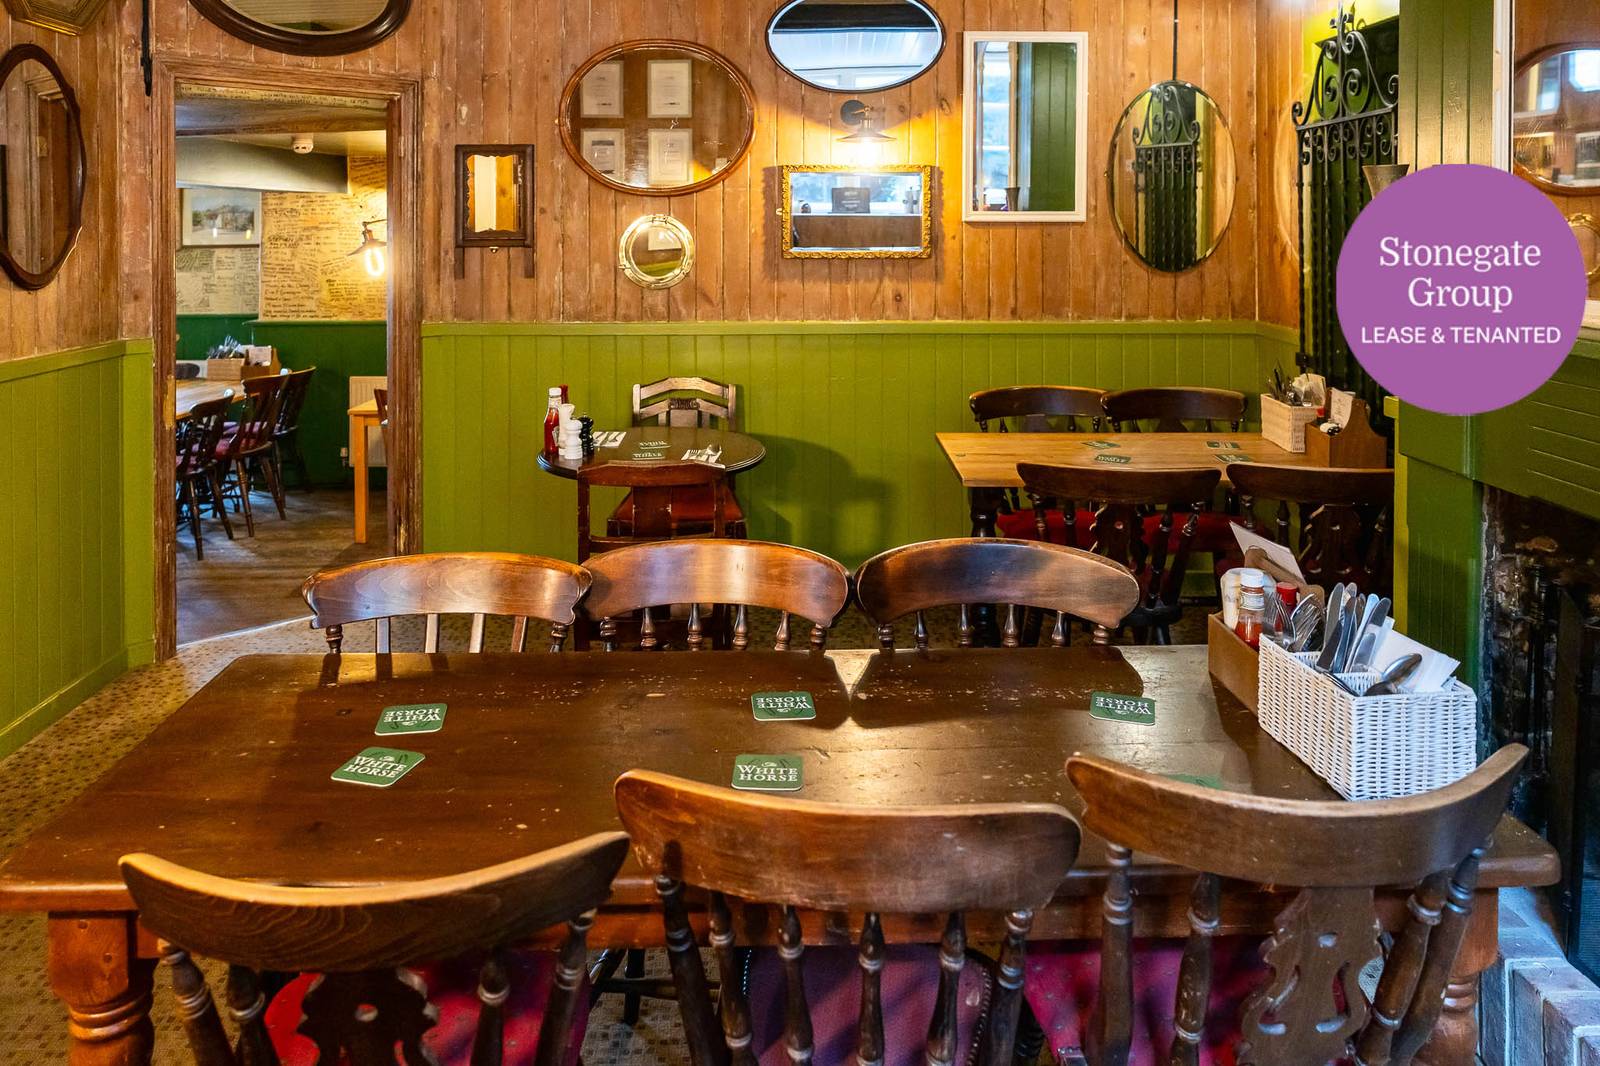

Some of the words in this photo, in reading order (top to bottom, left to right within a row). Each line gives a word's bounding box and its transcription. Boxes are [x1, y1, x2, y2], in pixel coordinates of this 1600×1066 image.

[1095, 696, 1149, 707] HORSE
[385, 708, 441, 717] HORSE
[1096, 701, 1152, 715] WHITE
[384, 713, 442, 723] WHITE
[354, 756, 407, 771] WHITE
[343, 764, 400, 778] HORSE
[736, 764, 798, 775] WHITE
[738, 773, 798, 782] HORSE
